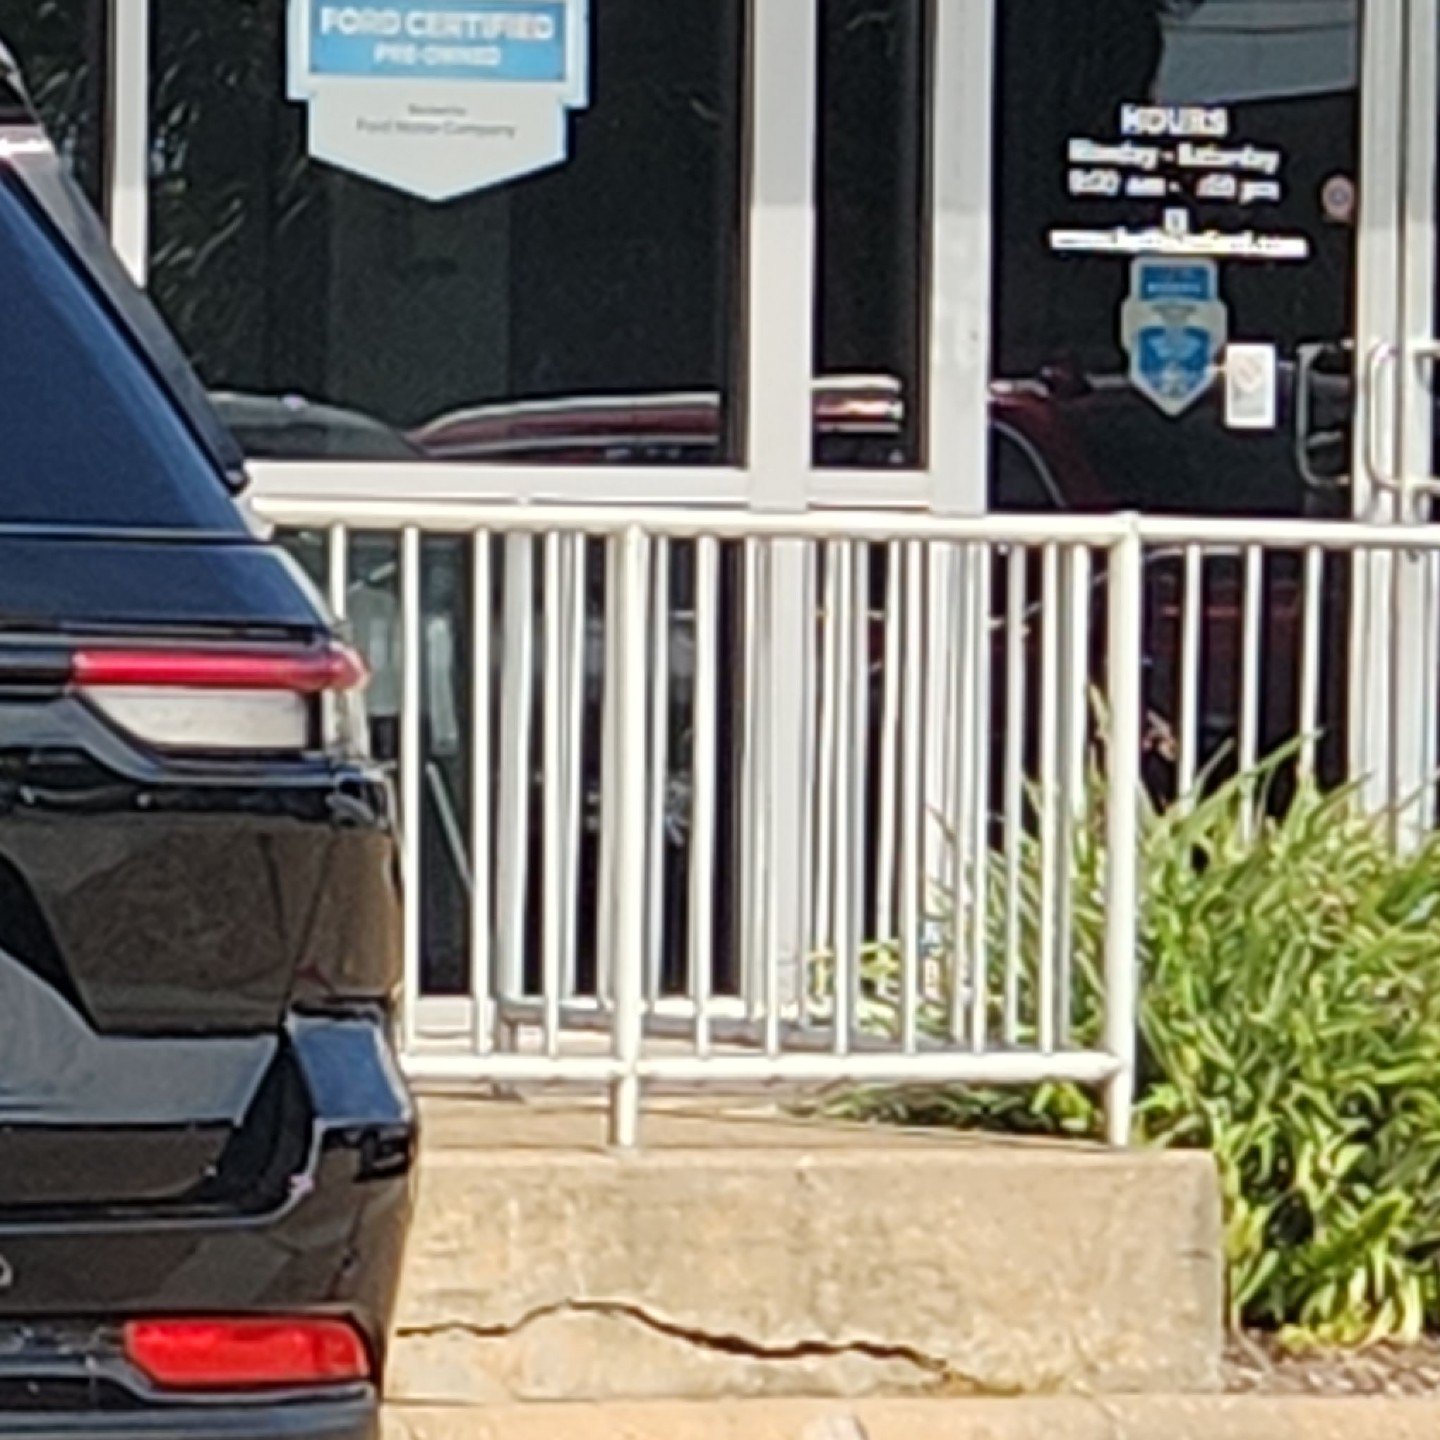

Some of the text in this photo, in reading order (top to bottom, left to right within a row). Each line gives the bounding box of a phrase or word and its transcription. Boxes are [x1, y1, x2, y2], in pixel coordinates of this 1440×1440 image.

[320, 6, 554, 40] FORD CERTIFIED
[373, 42, 501, 66] PRE-OWNED
[1120, 103, 1228, 137] HOURS
